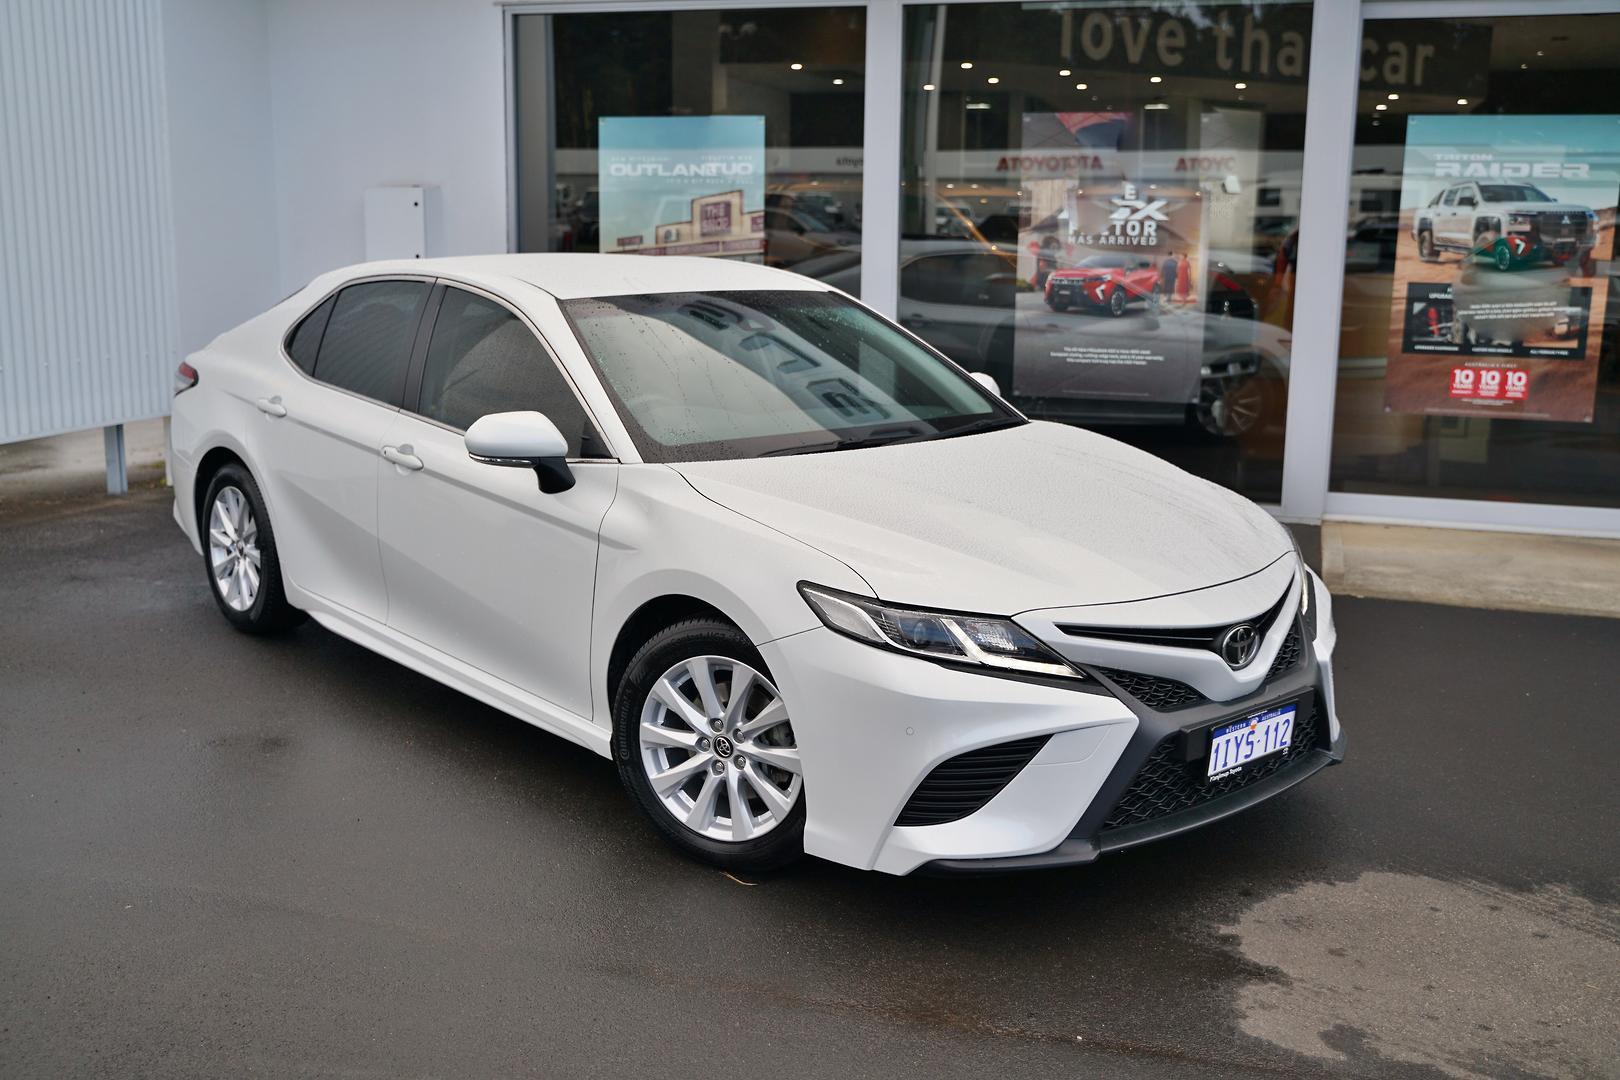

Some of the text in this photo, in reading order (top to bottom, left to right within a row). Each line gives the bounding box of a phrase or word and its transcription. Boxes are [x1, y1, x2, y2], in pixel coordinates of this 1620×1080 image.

[1061, 9, 1435, 87] love tha car
[1434, 162, 1591, 178] RAIDER
[1068, 235, 1158, 246] HAS ARRIVED
[1453, 369, 1527, 387] 10 10 10
